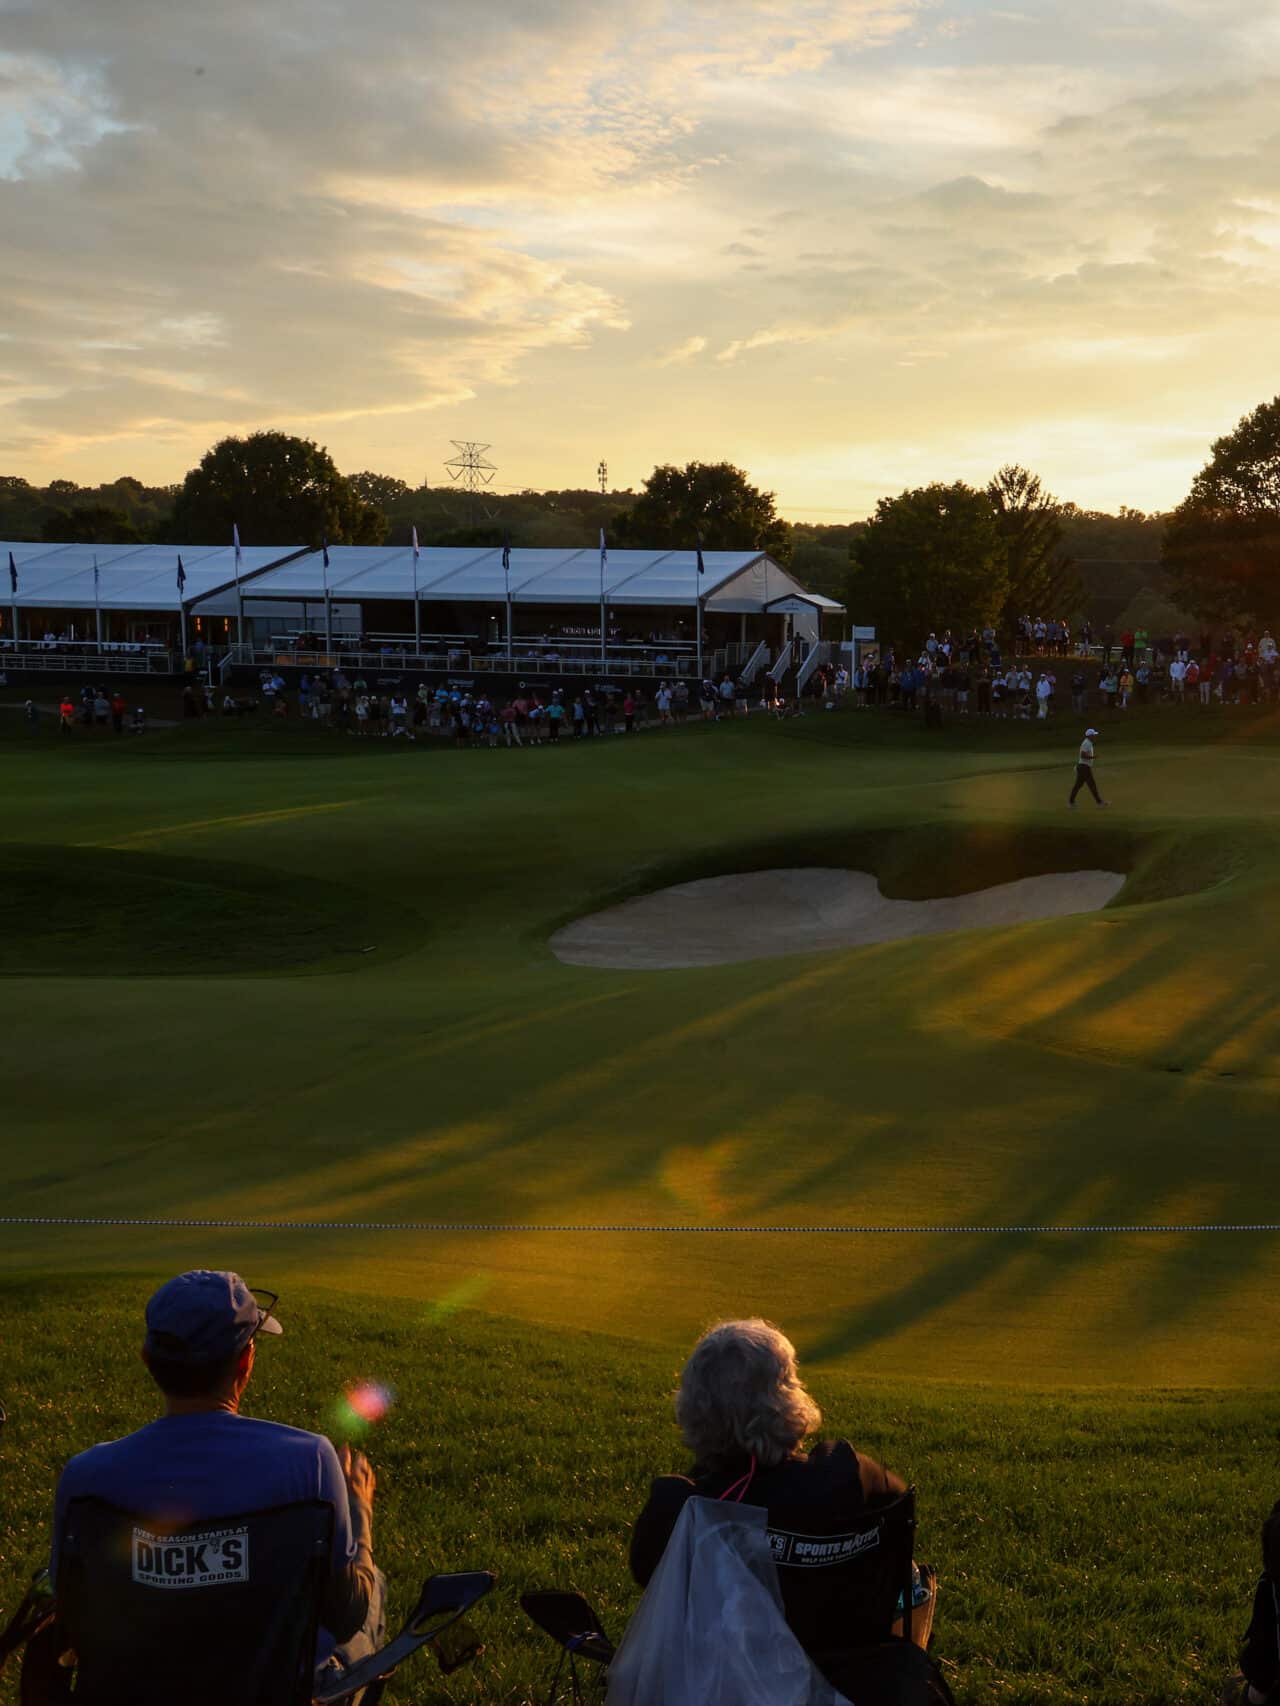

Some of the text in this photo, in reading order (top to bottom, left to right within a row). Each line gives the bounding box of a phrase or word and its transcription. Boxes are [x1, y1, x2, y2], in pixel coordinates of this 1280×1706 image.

[134, 1526, 249, 1543] EVERY SEASON STARTS AT
[138, 1538, 241, 1575] DICK'S
[795, 1542, 842, 1556] SPORTS
[138, 1571, 242, 1584] SPORTING GOODS
